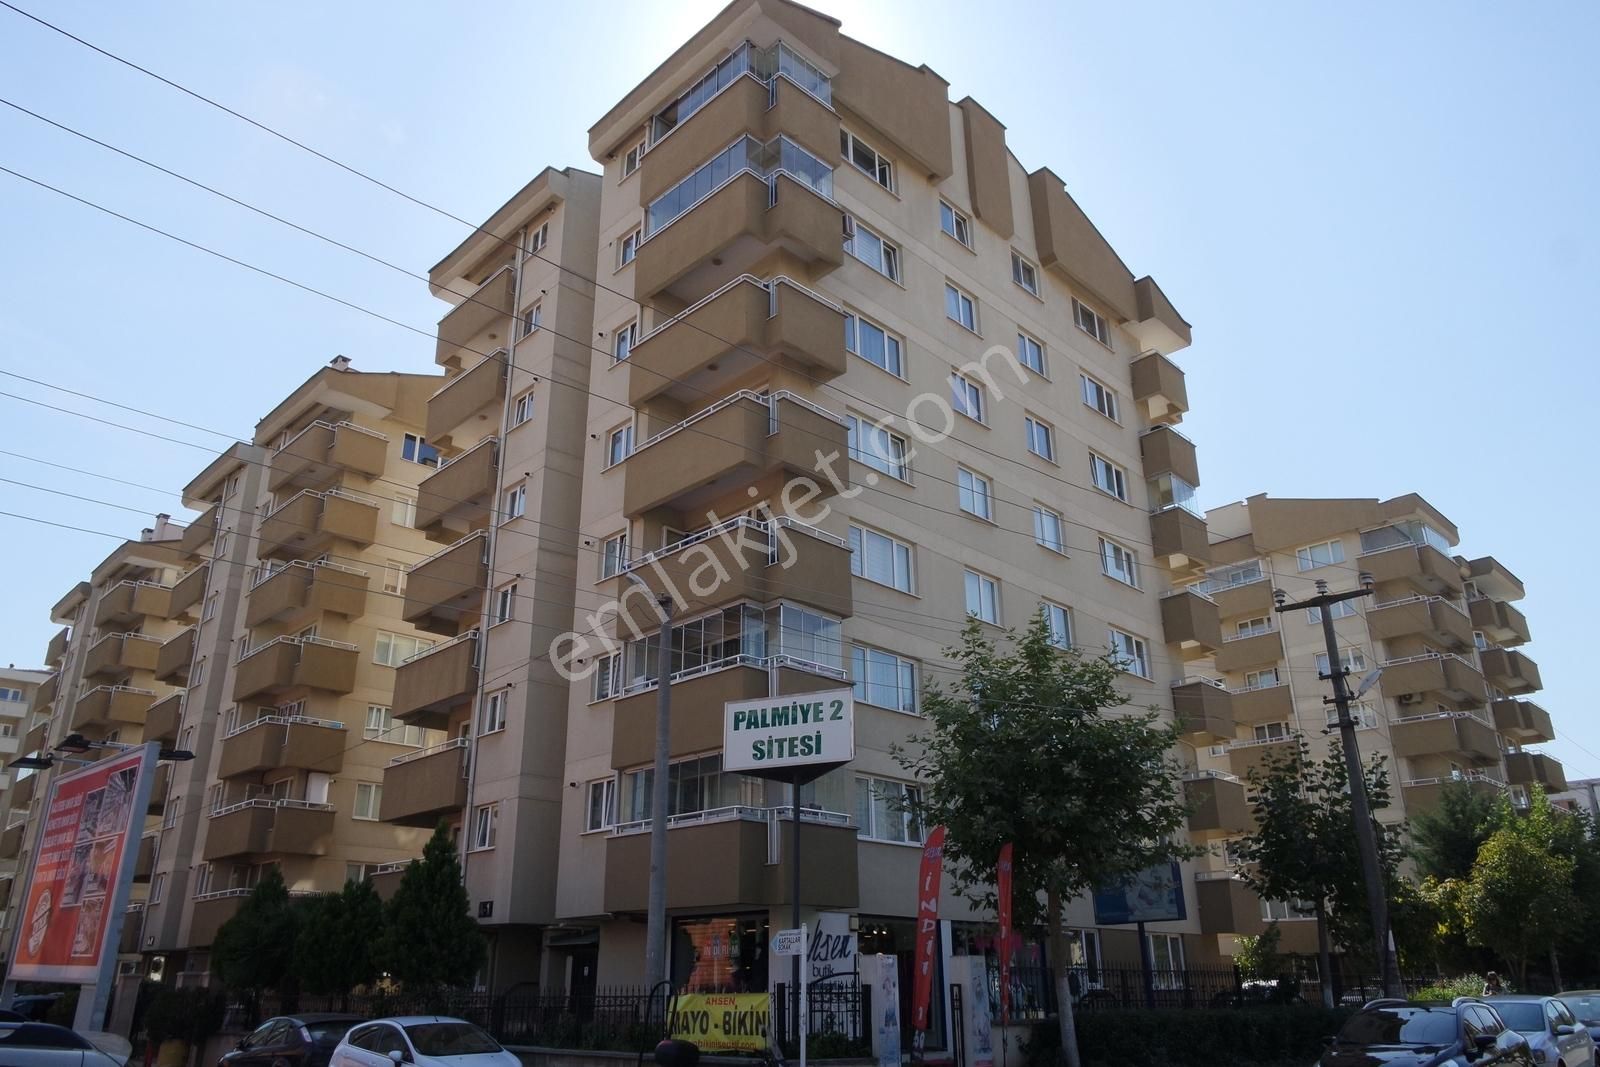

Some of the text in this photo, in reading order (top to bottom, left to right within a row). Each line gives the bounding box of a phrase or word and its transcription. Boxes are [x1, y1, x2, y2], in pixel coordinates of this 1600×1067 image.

[733, 699, 843, 731] PALMİYE 2
[752, 730, 822, 760] SİTESİ
[812, 963, 834, 978] butik
[705, 997, 736, 1006] AHSEN
[672, 1010, 709, 1035] MAYO
